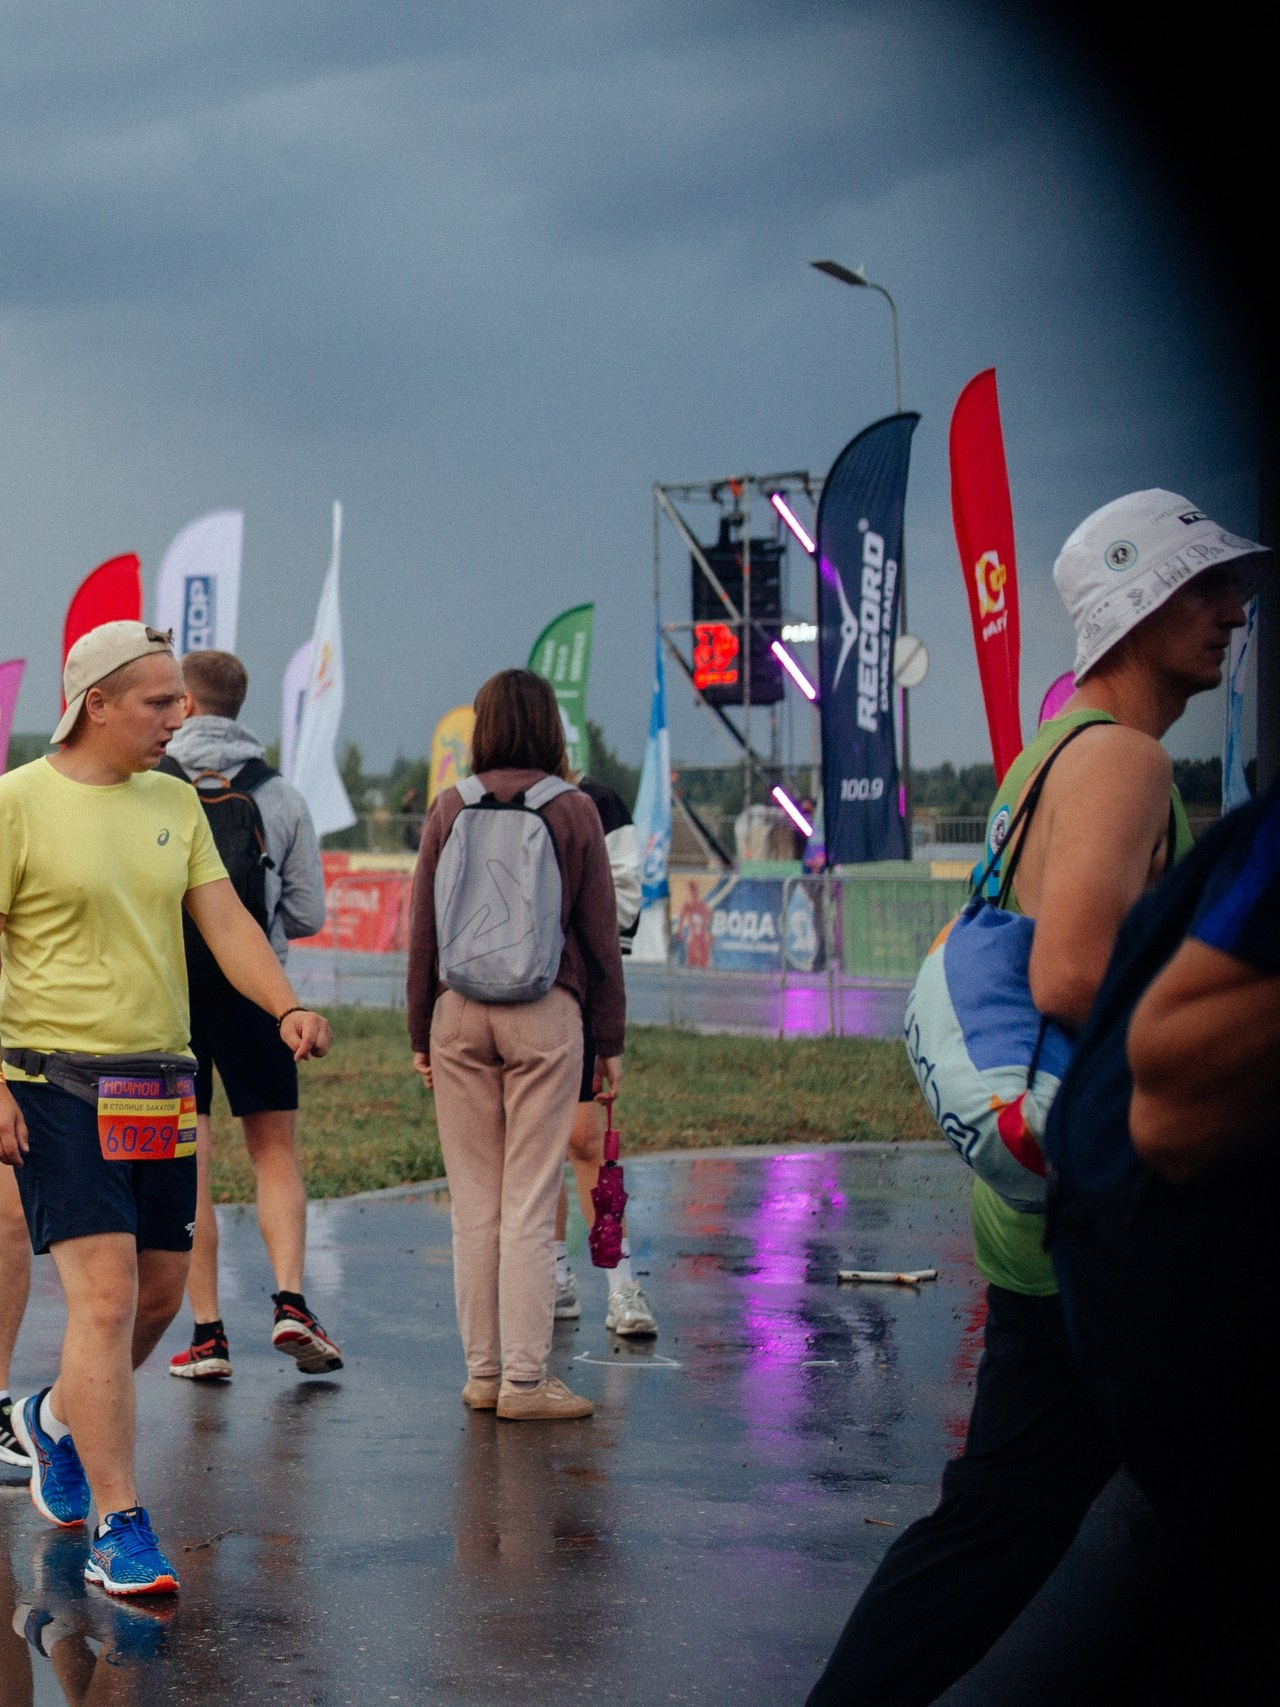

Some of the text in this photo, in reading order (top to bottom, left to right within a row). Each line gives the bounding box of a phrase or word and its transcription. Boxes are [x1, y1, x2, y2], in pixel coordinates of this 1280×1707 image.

[880, 558, 898, 629] RADIO
[857, 530, 885, 733] RECORD
[840, 776, 884, 801] 100.9
[710, 909, 776, 940] ВОДА
[103, 1080, 160, 1096] НОЧНОЙ
[109, 1103, 144, 1112] СТОЛИЦЕ
[145, 1103, 176, 1111] ЗАКАТОВ
[106, 1124, 175, 1153] 6029
